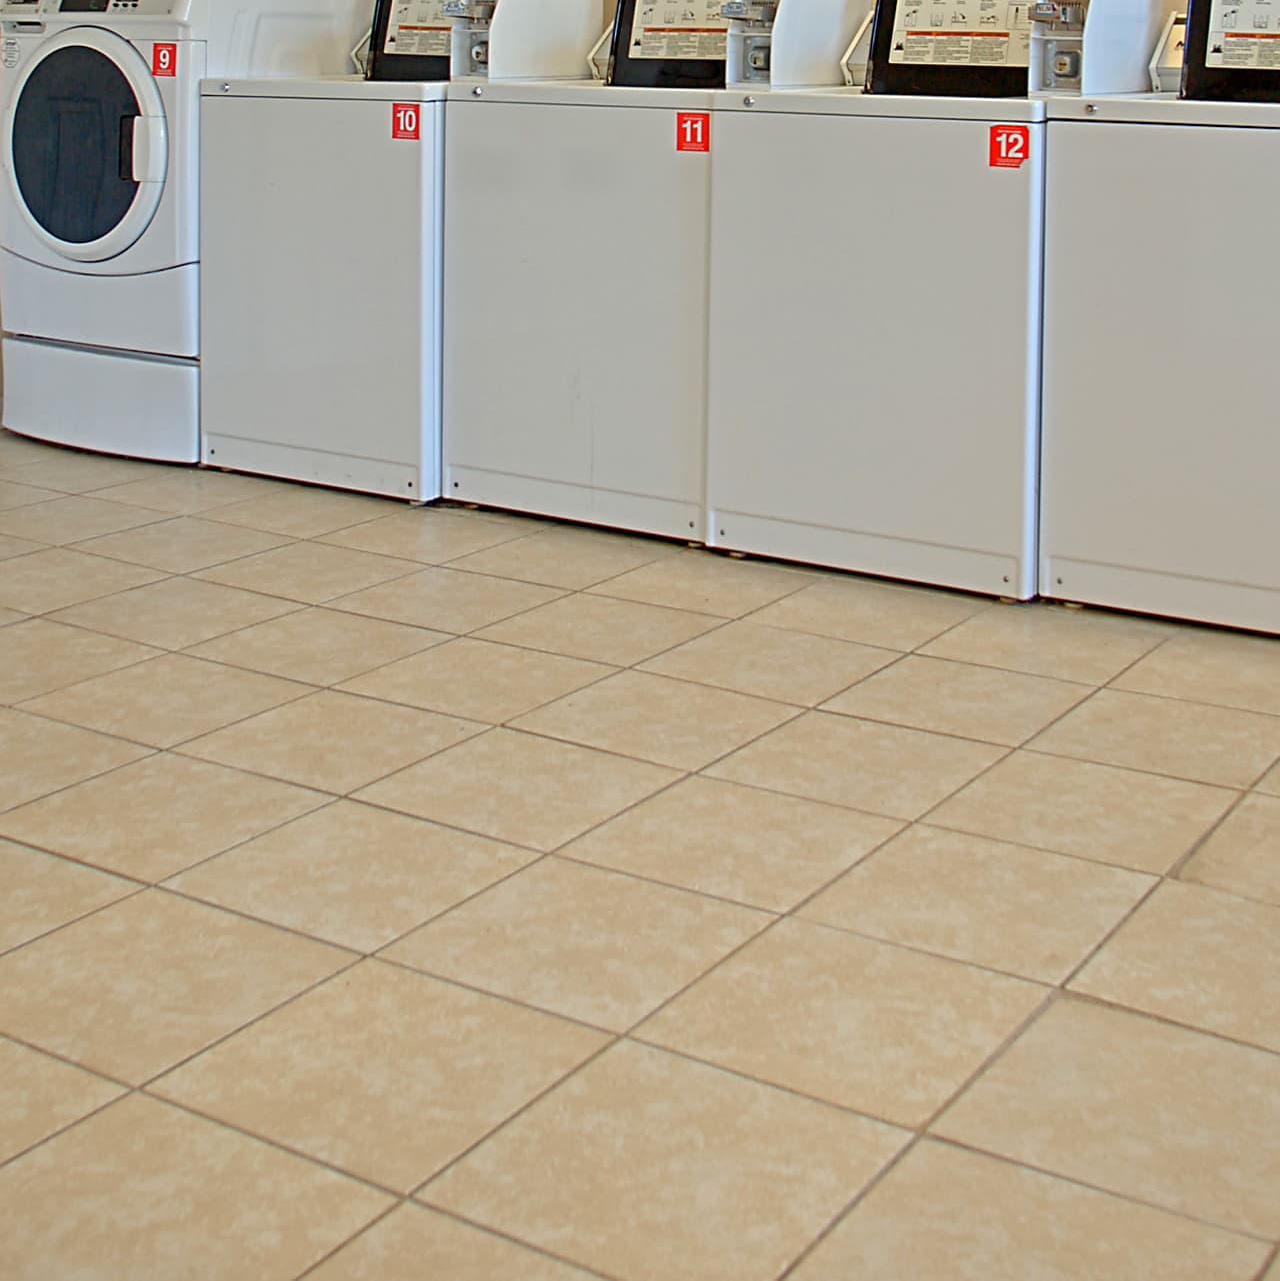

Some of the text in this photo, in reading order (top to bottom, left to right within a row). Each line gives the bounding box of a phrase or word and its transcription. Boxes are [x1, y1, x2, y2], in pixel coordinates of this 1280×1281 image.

[159, 49, 170, 69] 9
[396, 110, 417, 132] 10
[681, 119, 703, 143] 11
[995, 133, 1024, 158] 12
